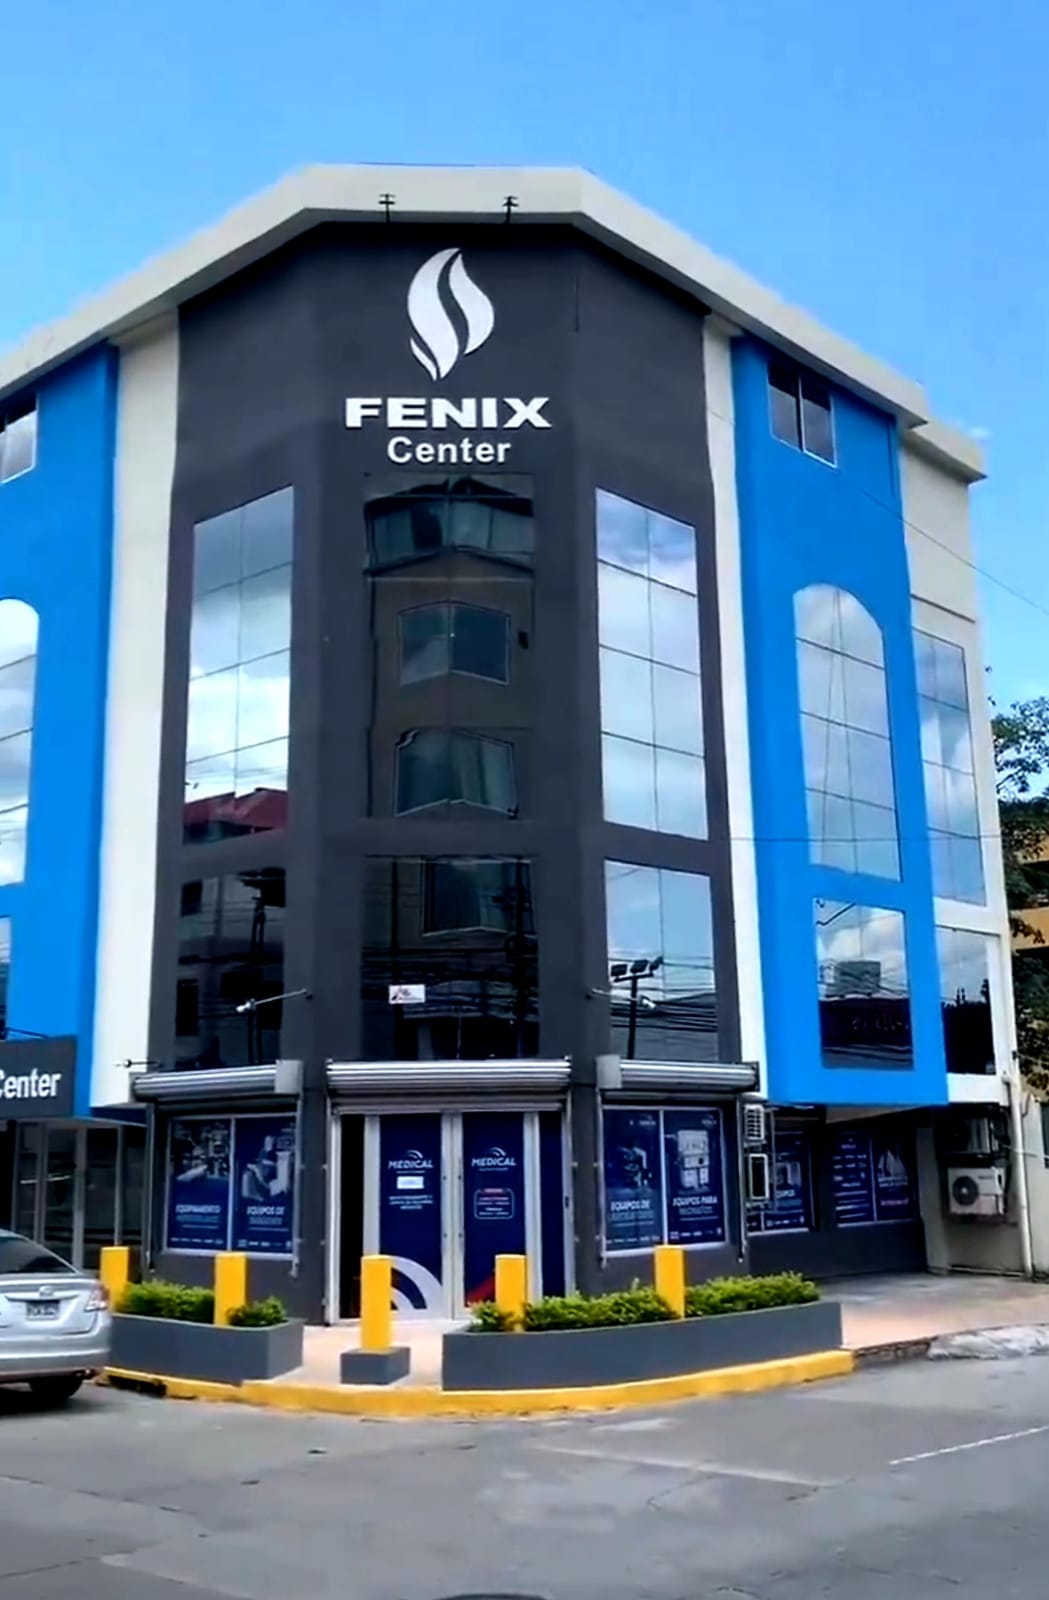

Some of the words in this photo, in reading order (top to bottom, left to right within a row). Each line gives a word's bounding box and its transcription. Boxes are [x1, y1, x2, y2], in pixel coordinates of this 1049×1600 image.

[345, 397, 552, 428] FENIX
[387, 436, 511, 464] Center
[388, 1160, 434, 1169] MEDICAL
[471, 1157, 517, 1167] MEDICAL
